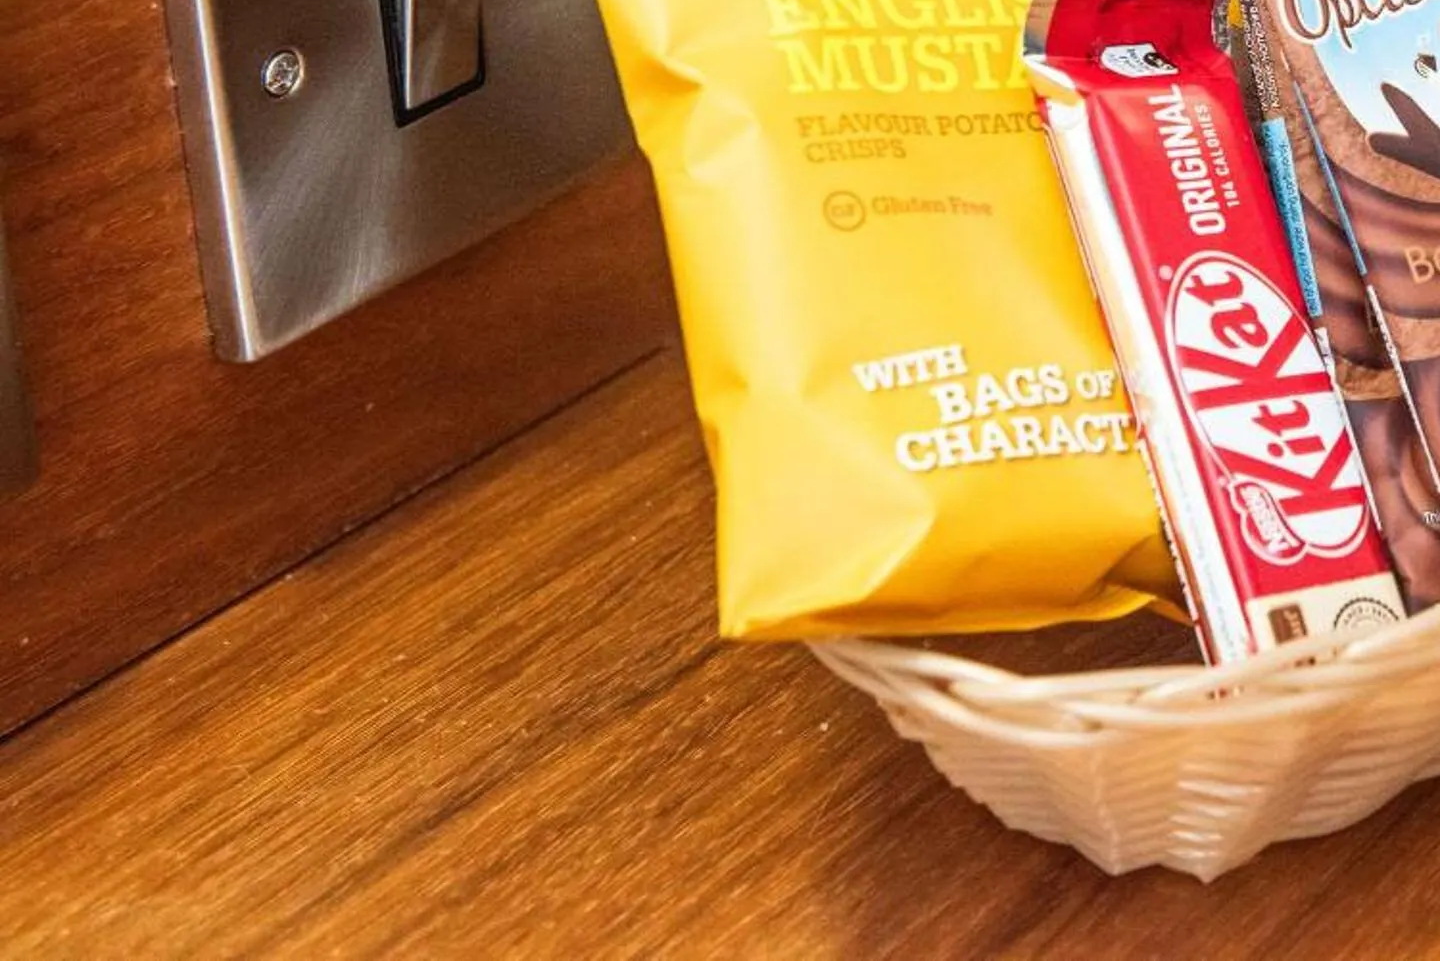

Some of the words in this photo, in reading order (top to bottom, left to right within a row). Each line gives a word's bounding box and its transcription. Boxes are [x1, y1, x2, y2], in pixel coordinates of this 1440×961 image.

[795, 111, 936, 139] FLAVOUR
[805, 139, 907, 164] CRISPS
[1195, 104, 1230, 176] CALORIES
[1147, 84, 1226, 236] ORIGINAL
[871, 195, 947, 218] Gluten
[950, 197, 993, 219] Free
[853, 343, 968, 392] WITH
[929, 364, 1069, 426] BAGS
[1076, 369, 1117, 400] OF
[1176, 269, 1367, 518] KitKat
[896, 412, 1134, 472] CHARACT
